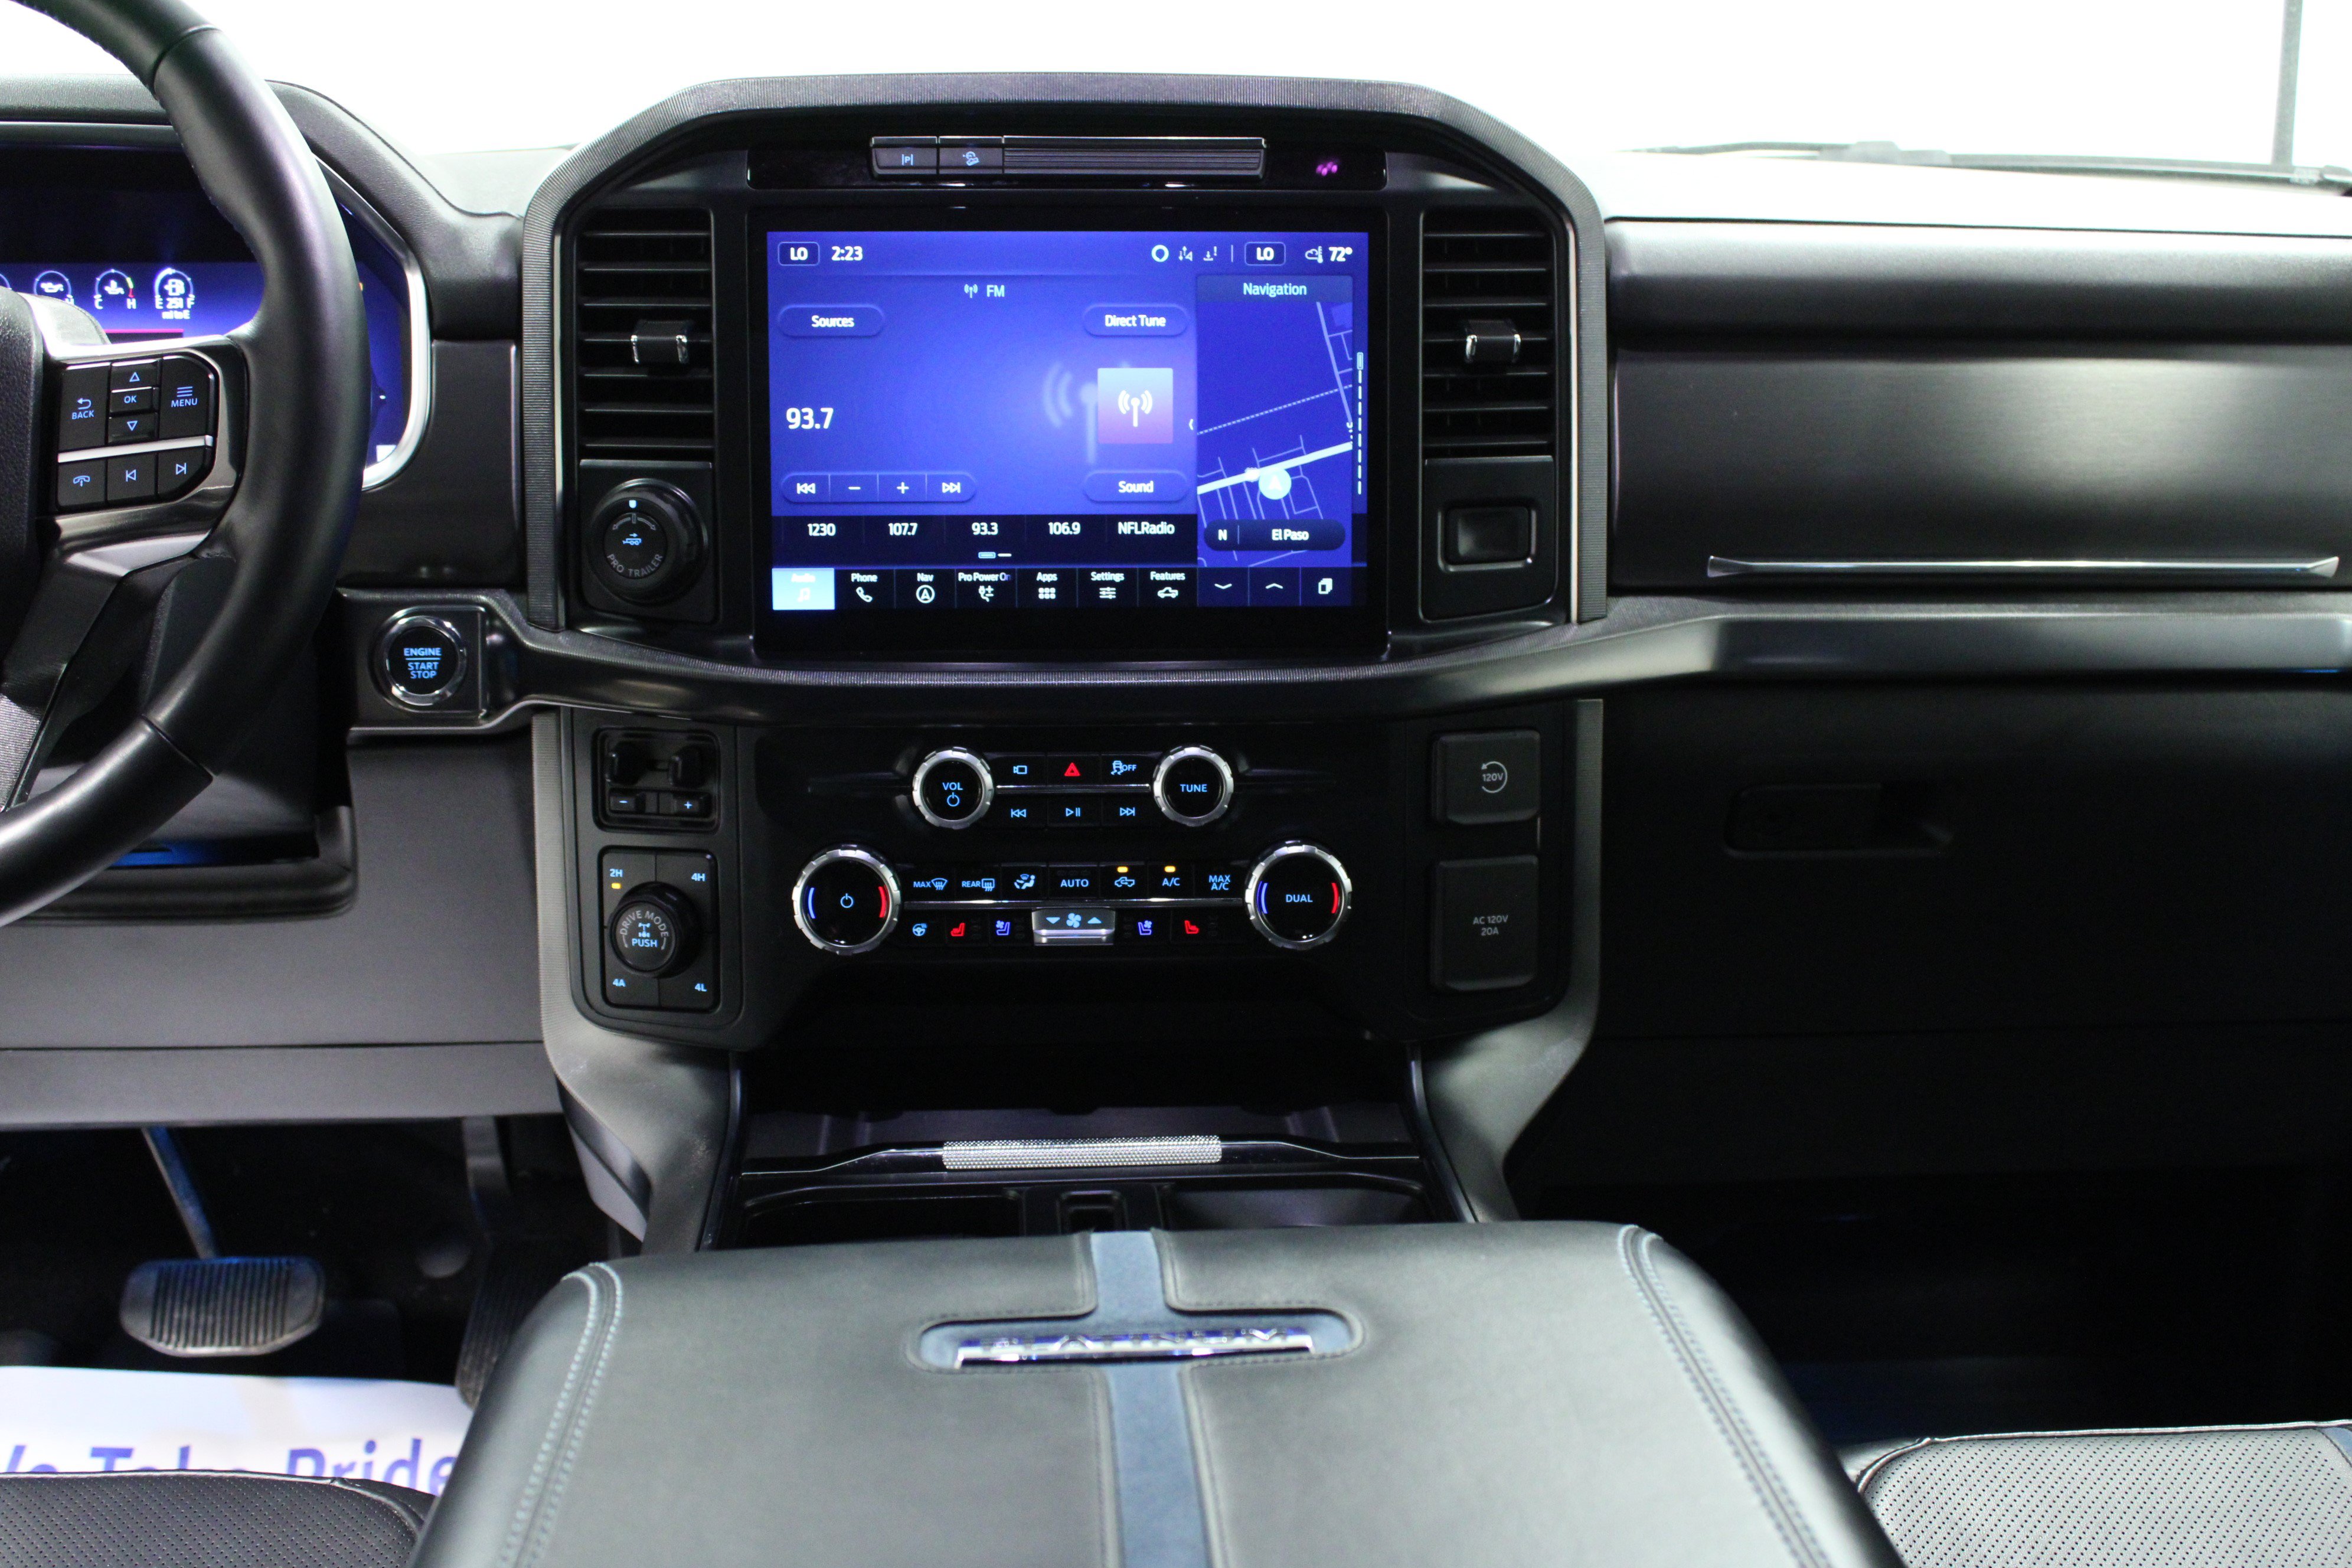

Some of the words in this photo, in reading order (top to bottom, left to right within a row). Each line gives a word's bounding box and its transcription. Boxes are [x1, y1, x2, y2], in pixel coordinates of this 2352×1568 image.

[790, 247, 808, 261] LO
[831, 246, 863, 262] 2:23
[1256, 247, 1275, 261] LO
[1328, 246, 1353, 262] 72°
[986, 284, 1005, 298] FM
[1243, 282, 1307, 298] Navigation
[94, 298, 103, 310] C
[126, 298, 137, 309] H
[155, 298, 164, 309] E
[186, 298, 195, 309] F
[811, 315, 855, 328] Sources
[1105, 314, 1138, 327] Direct
[1138, 314, 1167, 327] Tune
[123, 395, 137, 404] OK
[171, 397, 198, 408] MENU
[71, 410, 94, 420] BACK
[786, 407, 834, 430] 93.7
[1118, 480, 1154, 494] Sound
[807, 522, 837, 537] 1230
[888, 522, 918, 536] 107.7
[971, 522, 999, 535] 93.3
[1048, 521, 1082, 536] 106.9
[1218, 529, 1227, 541] N
[1271, 528, 1283, 541] El
[1283, 528, 1309, 541] Paso
[607, 553, 625, 573] PRO
[627, 554, 664, 578] TRAILER
[851, 573, 878, 583] Phone
[917, 572, 934, 582] Nav
[958, 571, 973, 582] Pro
[973, 571, 999, 582] Power
[1036, 571, 1058, 583] Apps
[1090, 571, 1125, 583] Settings
[1150, 571, 1186, 581] Features
[403, 647, 442, 656] ENGINE
[407, 661, 439, 671] START
[410, 670, 437, 679] STOP
[1121, 764, 1138, 772] OFF
[1482, 773, 1504, 783] 120V
[942, 782, 963, 790] VOL
[1180, 784, 1207, 793] TUNE
[609, 868, 623, 878] 2H
[691, 873, 705, 882] 4H
[1208, 874, 1232, 883] MAX
[913, 880, 931, 888] MAX
[961, 880, 981, 888] REAR
[1060, 878, 1089, 888] AUTO
[1162, 877, 1180, 887] A/C
[1210, 881, 1230, 891] A/C
[1286, 894, 1313, 903] DUAL
[620, 910, 643, 936] DRIVE
[645, 910, 669, 937] MODE
[1472, 916, 1485, 925] AC
[1487, 914, 1508, 925] 120V
[1481, 927, 1499, 936] 20A
[631, 937, 658, 948] PUSH
[612, 978, 626, 987] 4A
[694, 983, 707, 992] 4L
